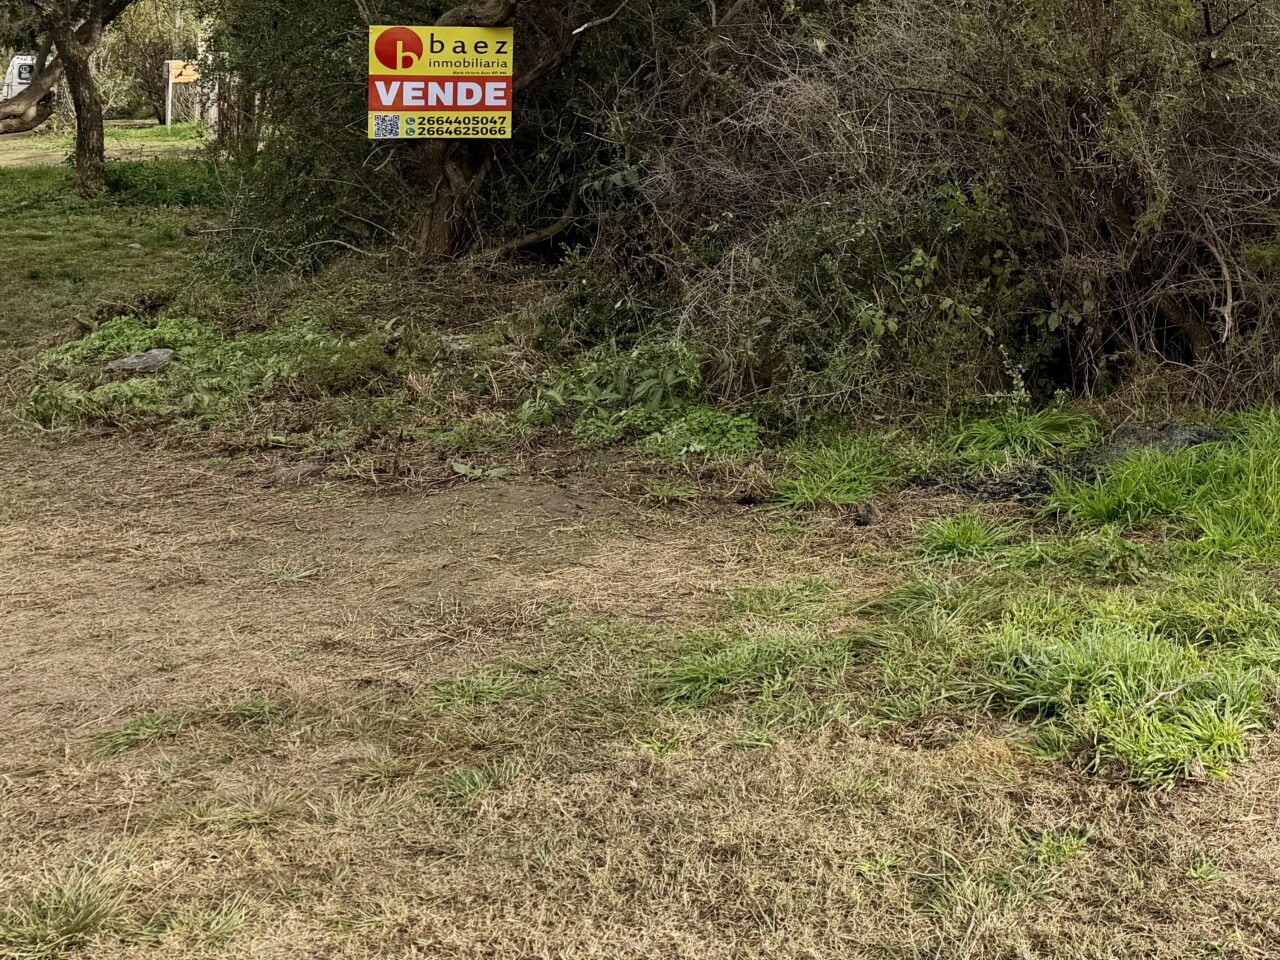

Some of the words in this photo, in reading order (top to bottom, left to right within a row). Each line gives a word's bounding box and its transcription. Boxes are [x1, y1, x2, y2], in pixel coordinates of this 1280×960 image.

[430, 33, 508, 55] baez
[429, 58, 508, 68] inmobiliaria
[375, 81, 507, 106] VENDE
[418, 116, 507, 125] 2664405047
[418, 127, 507, 136] 2664625066
